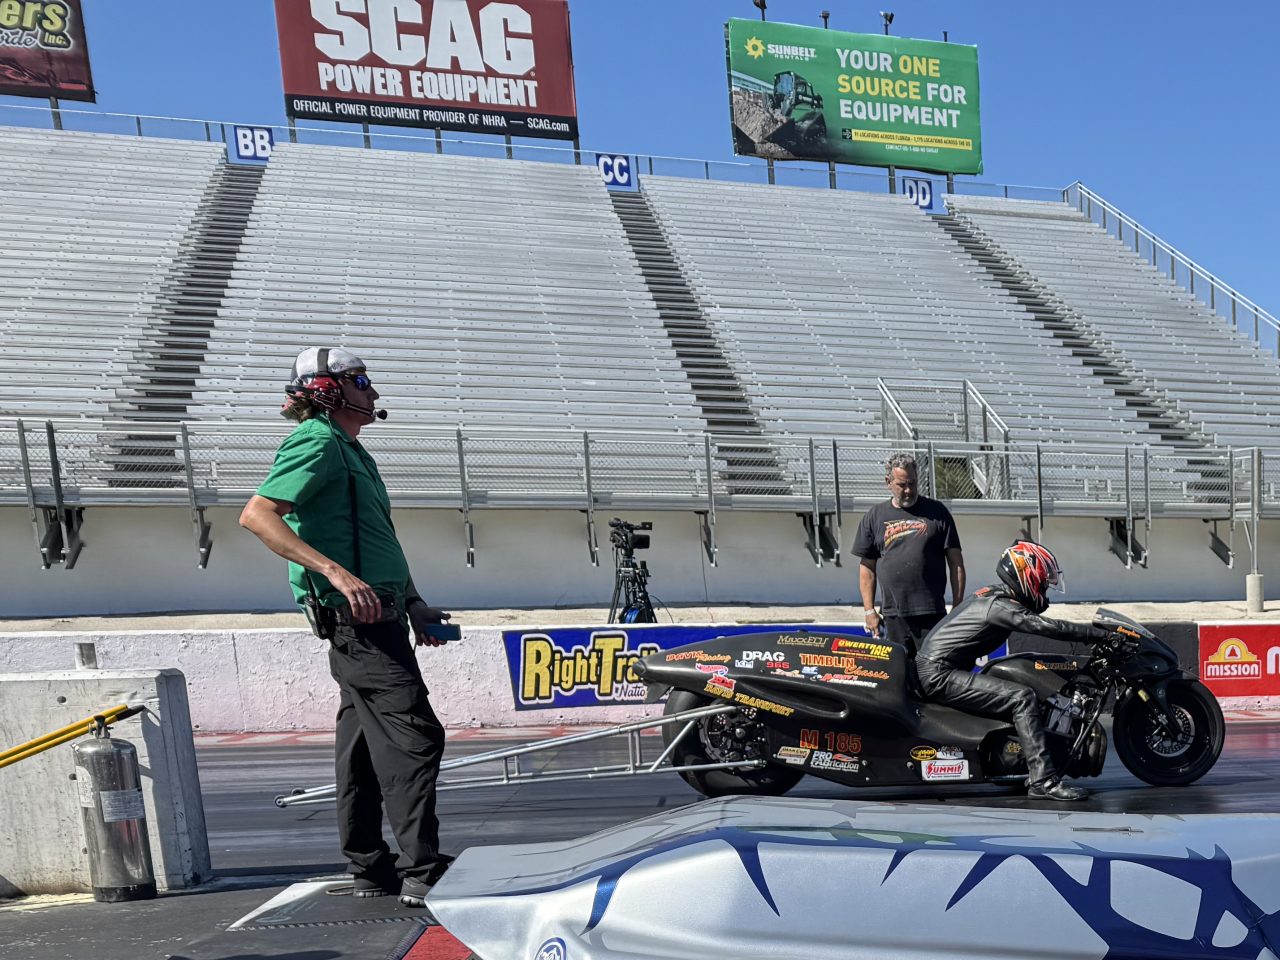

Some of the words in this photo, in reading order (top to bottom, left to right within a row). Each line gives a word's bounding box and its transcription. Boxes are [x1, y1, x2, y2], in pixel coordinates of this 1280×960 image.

[44, 32, 66, 44] Inc.
[311, 0, 536, 76] SCAG
[767, 44, 817, 58] SUNBELT
[836, 48, 893, 73] YOUR
[899, 54, 941, 77] ONE
[318, 62, 404, 97] POWER
[409, 70, 538, 108] EQUIPMENT
[837, 74, 921, 99] SOURCE
[926, 83, 967, 104] FOR
[293, 99, 333, 114] OFFICIAL
[335, 103, 367, 116] POWER
[370, 106, 420, 121] EQUIPMENT
[423, 111, 466, 124] PROVIDER
[468, 113, 480, 125] OF
[482, 115, 507, 127] NHRA
[527, 117, 570, 132] SCAG.com
[840, 99, 960, 128] EQUIPMENT
[237, 127, 272, 159] BB
[600, 156, 629, 183] CC
[904, 180, 932, 206] DD
[742, 651, 785, 662] DRAG
[799, 653, 856, 668] TIMBLIN
[870, 649, 890, 657] INC.
[844, 664, 890, 680] Chassis
[1207, 664, 1259, 678] MISSION
[734, 692, 795, 717] TRANSPORT
[800, 729, 818, 749] M
[824, 733, 862, 753] 185
[812, 750, 832, 760] PRO
